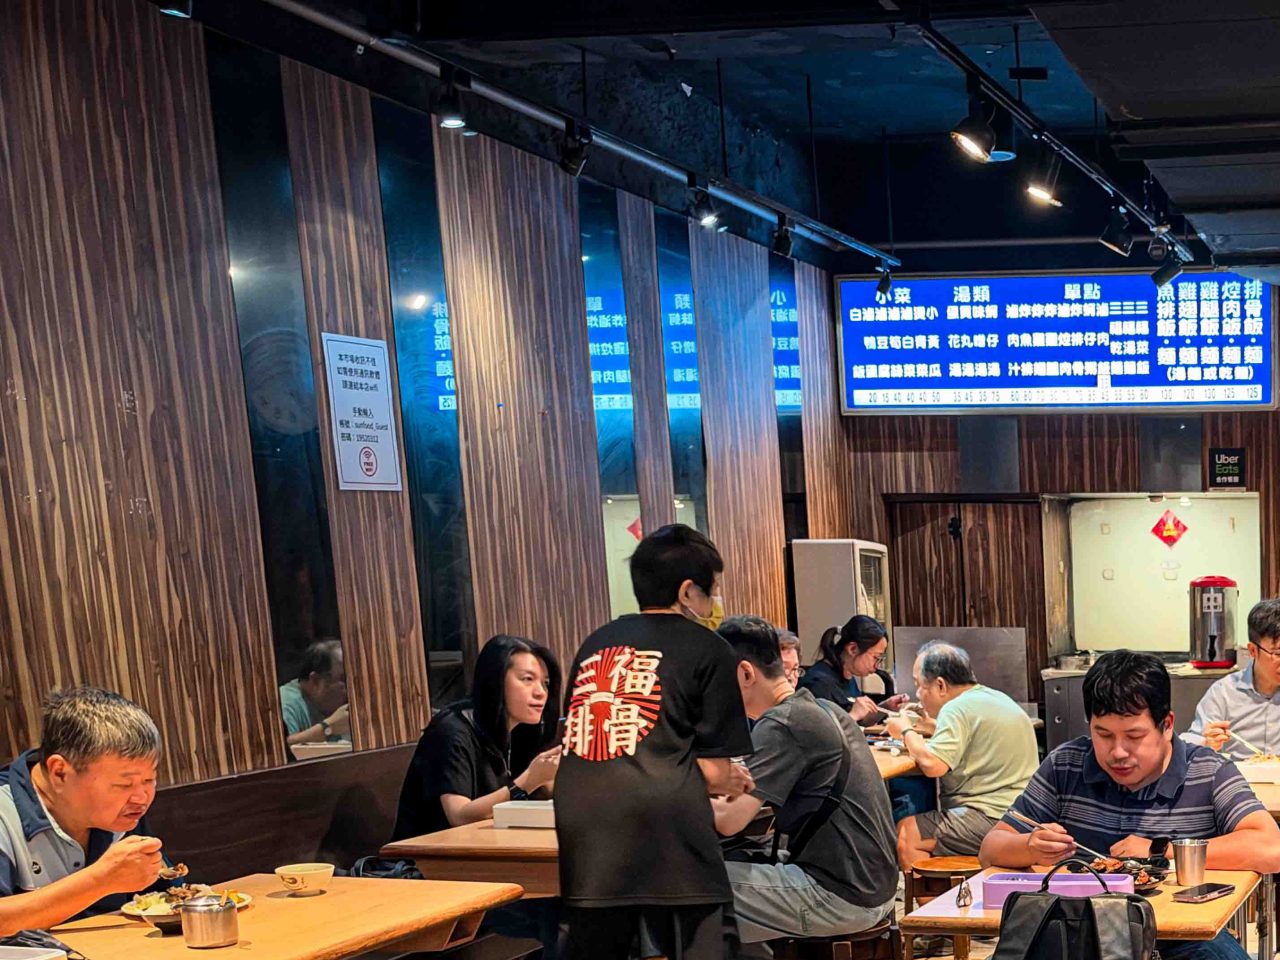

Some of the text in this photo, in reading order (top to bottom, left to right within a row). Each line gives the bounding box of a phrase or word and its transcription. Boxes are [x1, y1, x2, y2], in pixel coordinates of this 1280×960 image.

[876, 288, 911, 304] 小菜
[954, 286, 990, 303] 湯類
[1064, 283, 1101, 300] 單點
[1215, 454, 1239, 464] Uber
[1216, 464, 1239, 474] Eats
[573, 648, 663, 696] 三福
[562, 698, 647, 757] 排骨
